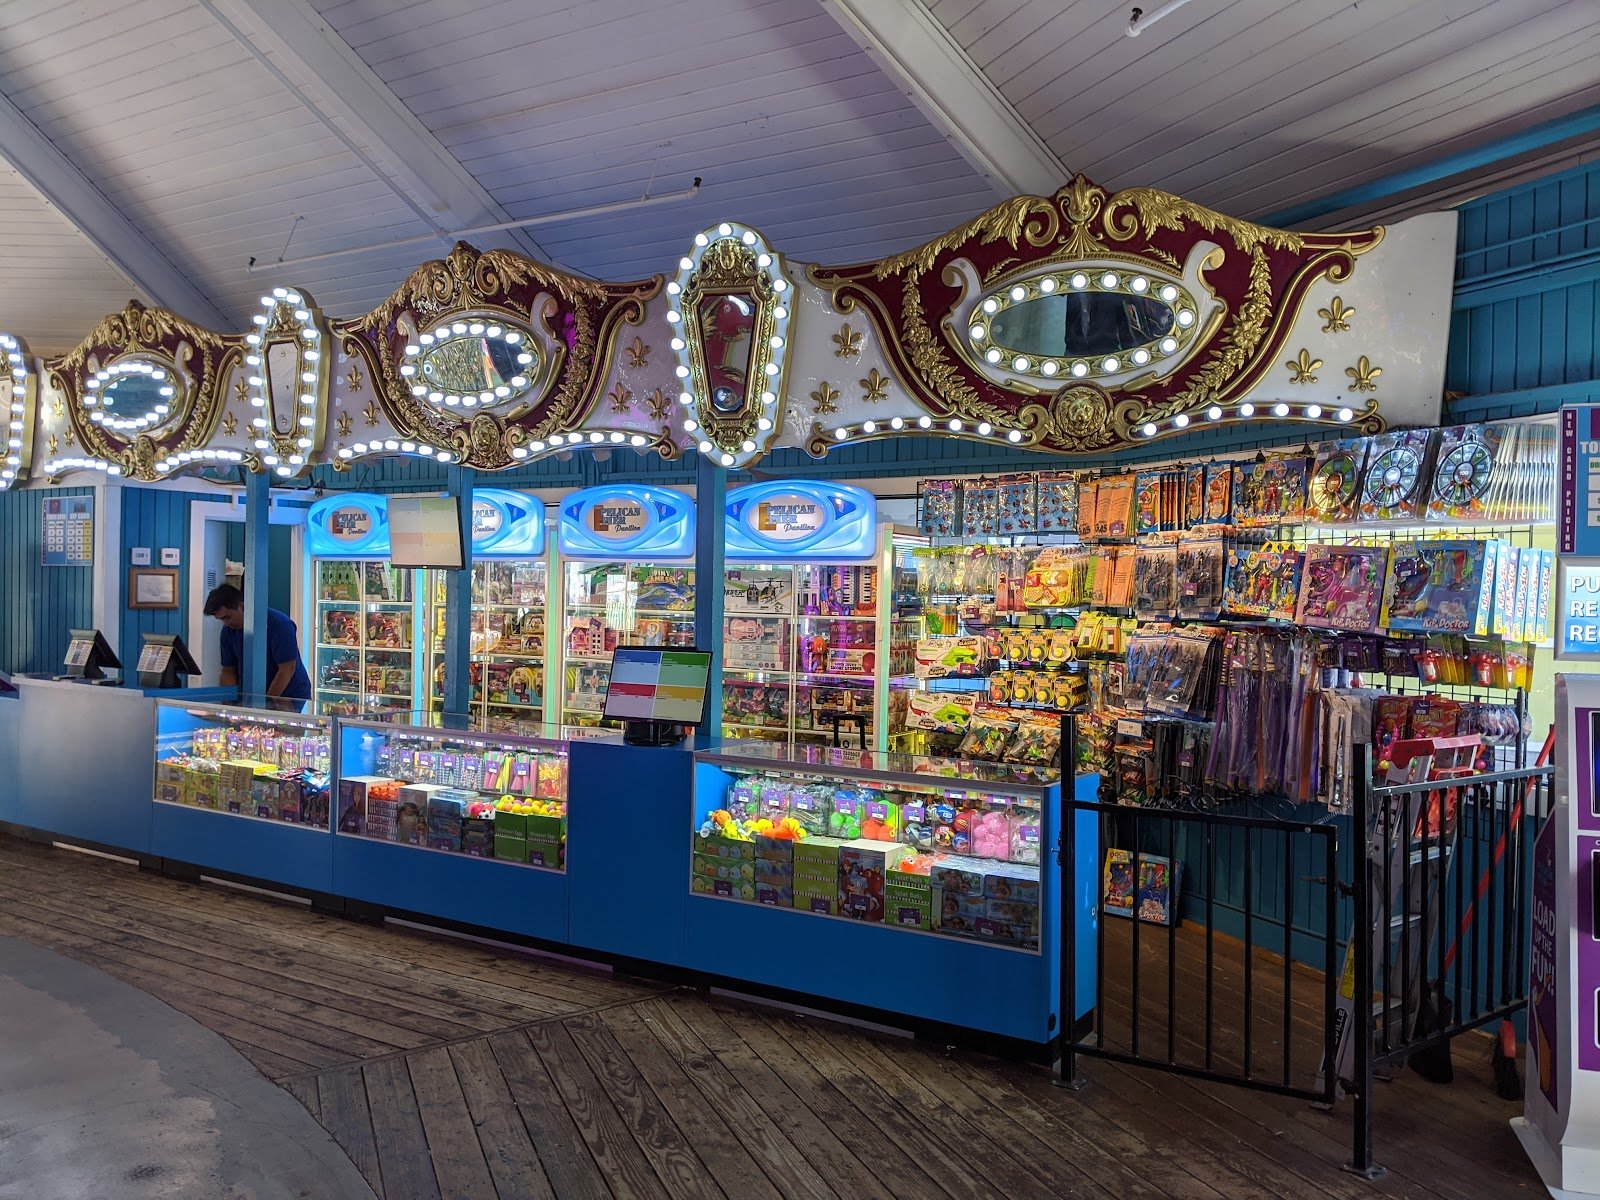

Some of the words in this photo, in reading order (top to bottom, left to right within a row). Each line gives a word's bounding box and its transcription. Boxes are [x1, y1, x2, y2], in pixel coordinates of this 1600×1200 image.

[1565, 412, 1574, 437] NEW
[1580, 441, 1600, 454] TO
[602, 507, 641, 516] PELICAN
[767, 504, 816, 514] PELICAN
[1564, 490, 1572, 550] PRICING
[1569, 624, 1600, 643] RE
[1533, 895, 1556, 936] LOAD
